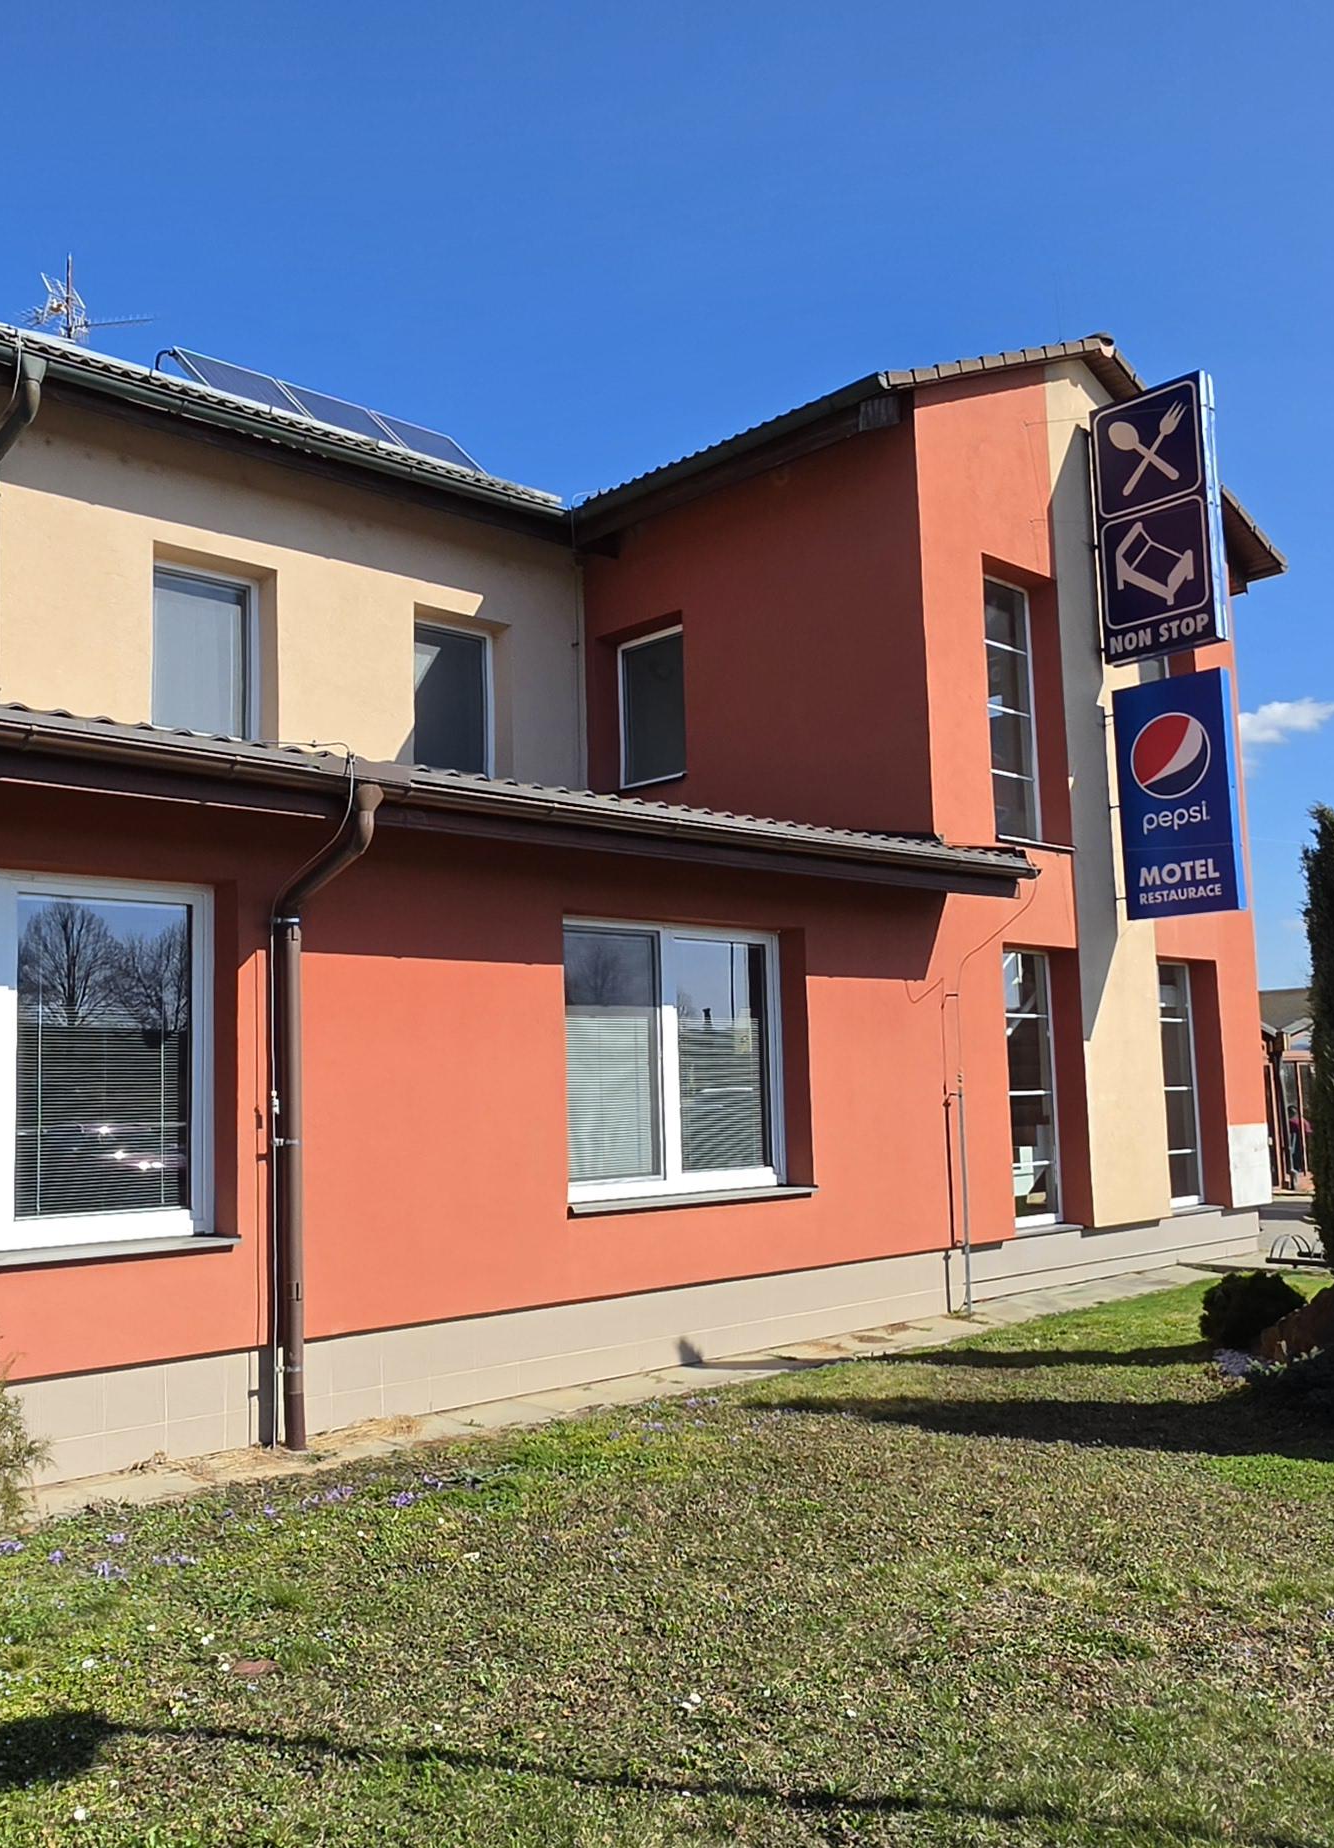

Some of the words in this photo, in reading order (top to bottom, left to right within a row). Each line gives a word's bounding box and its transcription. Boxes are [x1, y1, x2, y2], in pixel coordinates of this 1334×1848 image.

[1109, 629, 1152, 655] NON
[1159, 612, 1210, 641] STOP
[1142, 800, 1208, 835] pepsi
[1138, 858, 1220, 887] MOTEL
[1139, 883, 1223, 905] RESTAURACE
